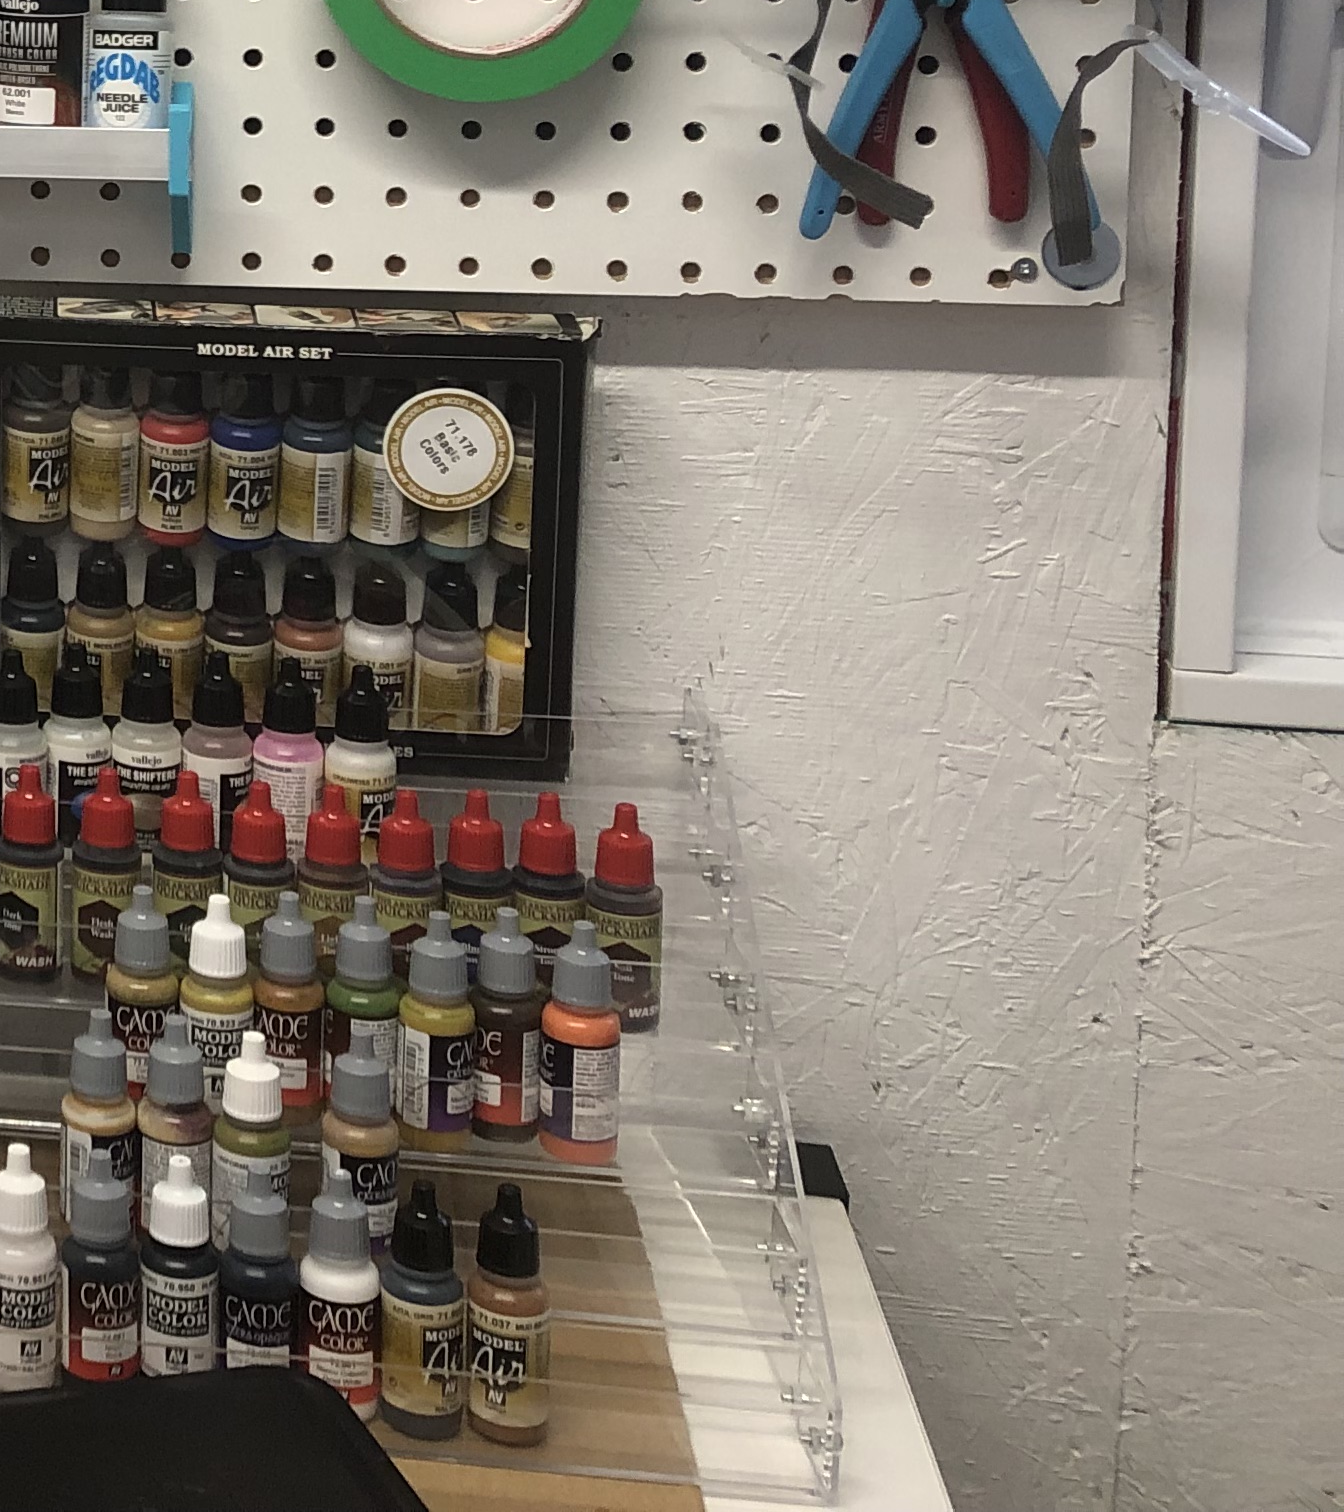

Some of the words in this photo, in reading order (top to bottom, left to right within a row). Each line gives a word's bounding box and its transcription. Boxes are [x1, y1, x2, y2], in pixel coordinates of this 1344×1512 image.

[94, 34, 153, 46] BADGER
[3, 89, 31, 98] 62.001
[97, 93, 148, 104] NEEDLE
[102, 104, 139, 113] JUICE
[197, 343, 258, 360] MODEL
[263, 344, 292, 359] AIR
[299, 345, 333, 360] SET
[434, 431, 461, 463] Basic
[419, 438, 450, 476] Colors
[151, 460, 195, 472] MODEL
[229, 469, 272, 479] MODEL
[148, 472, 196, 502] Air
[224, 480, 272, 512] Air
[165, 505, 179, 517] AV
[243, 512, 257, 524] AV
[131, 755, 162, 766] vallejo
[67, 766, 83, 777] THE
[133, 769, 176, 782] SHIFTERS
[91, 917, 114, 927] Flesh
[91, 927, 114, 938] Wash
[16, 956, 53, 967] WASH
[2, 1290, 55, 1305] MODEL
[148, 1294, 207, 1314] MODEL
[148, 1311, 207, 1328] COLOR
[227, 1298, 291, 1335] GAME
[309, 1299, 374, 1335] GAME
[473, 1331, 523, 1352] MODEL
[24, 1342, 41, 1357] AV
[167, 1348, 184, 1364] AV
[488, 1390, 506, 1405] AV
